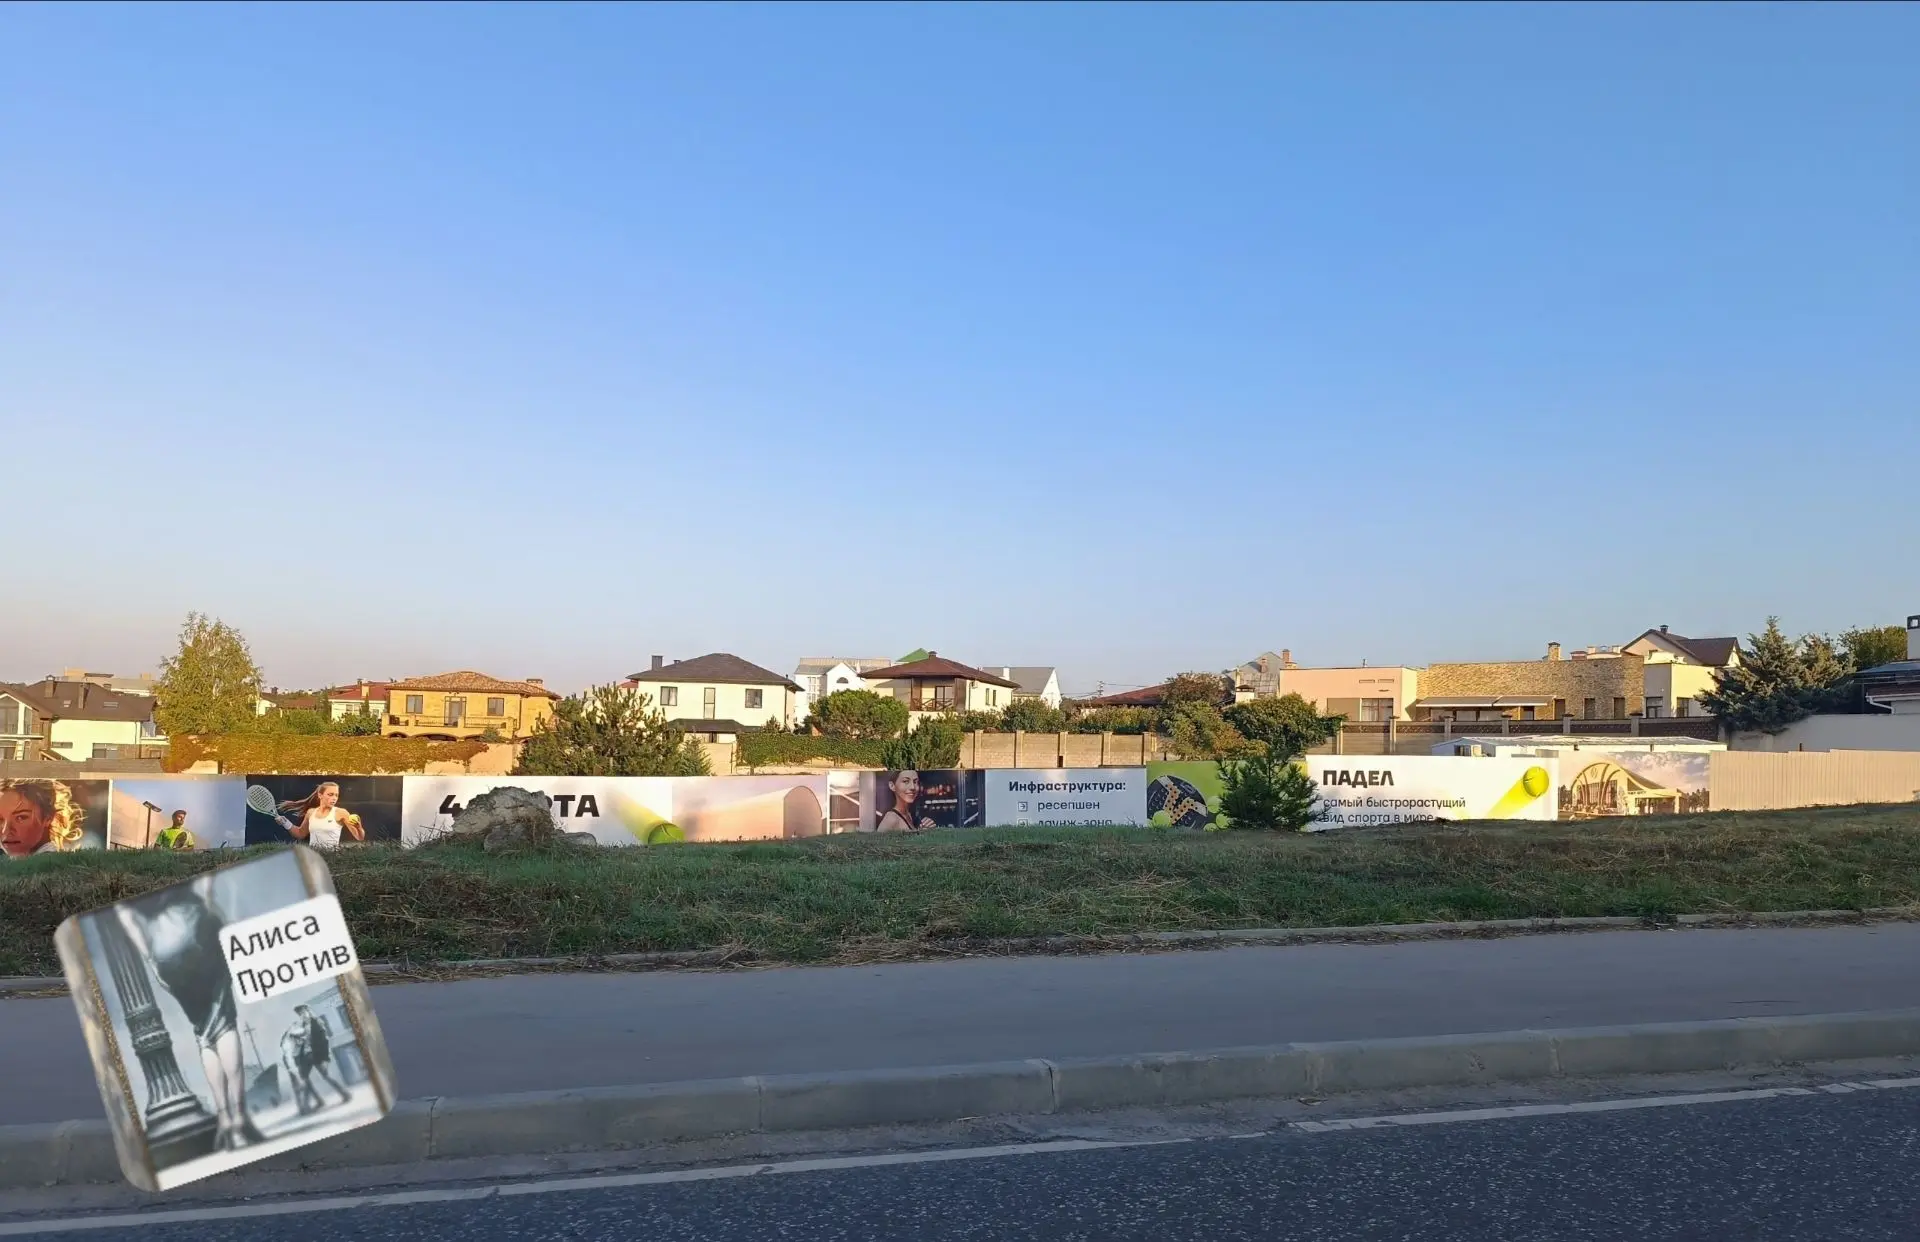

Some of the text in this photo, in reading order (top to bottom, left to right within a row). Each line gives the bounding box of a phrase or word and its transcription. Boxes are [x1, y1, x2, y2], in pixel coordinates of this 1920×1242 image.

[1322, 770, 1394, 788] ПАДЕЛ
[1008, 780, 1127, 794] Инфраструктура:
[1037, 800, 1100, 813] ресепшен
[1323, 796, 1466, 810] самый быстрорастущий
[1347, 813, 1391, 826] спорта
[1393, 813, 1401, 823] в
